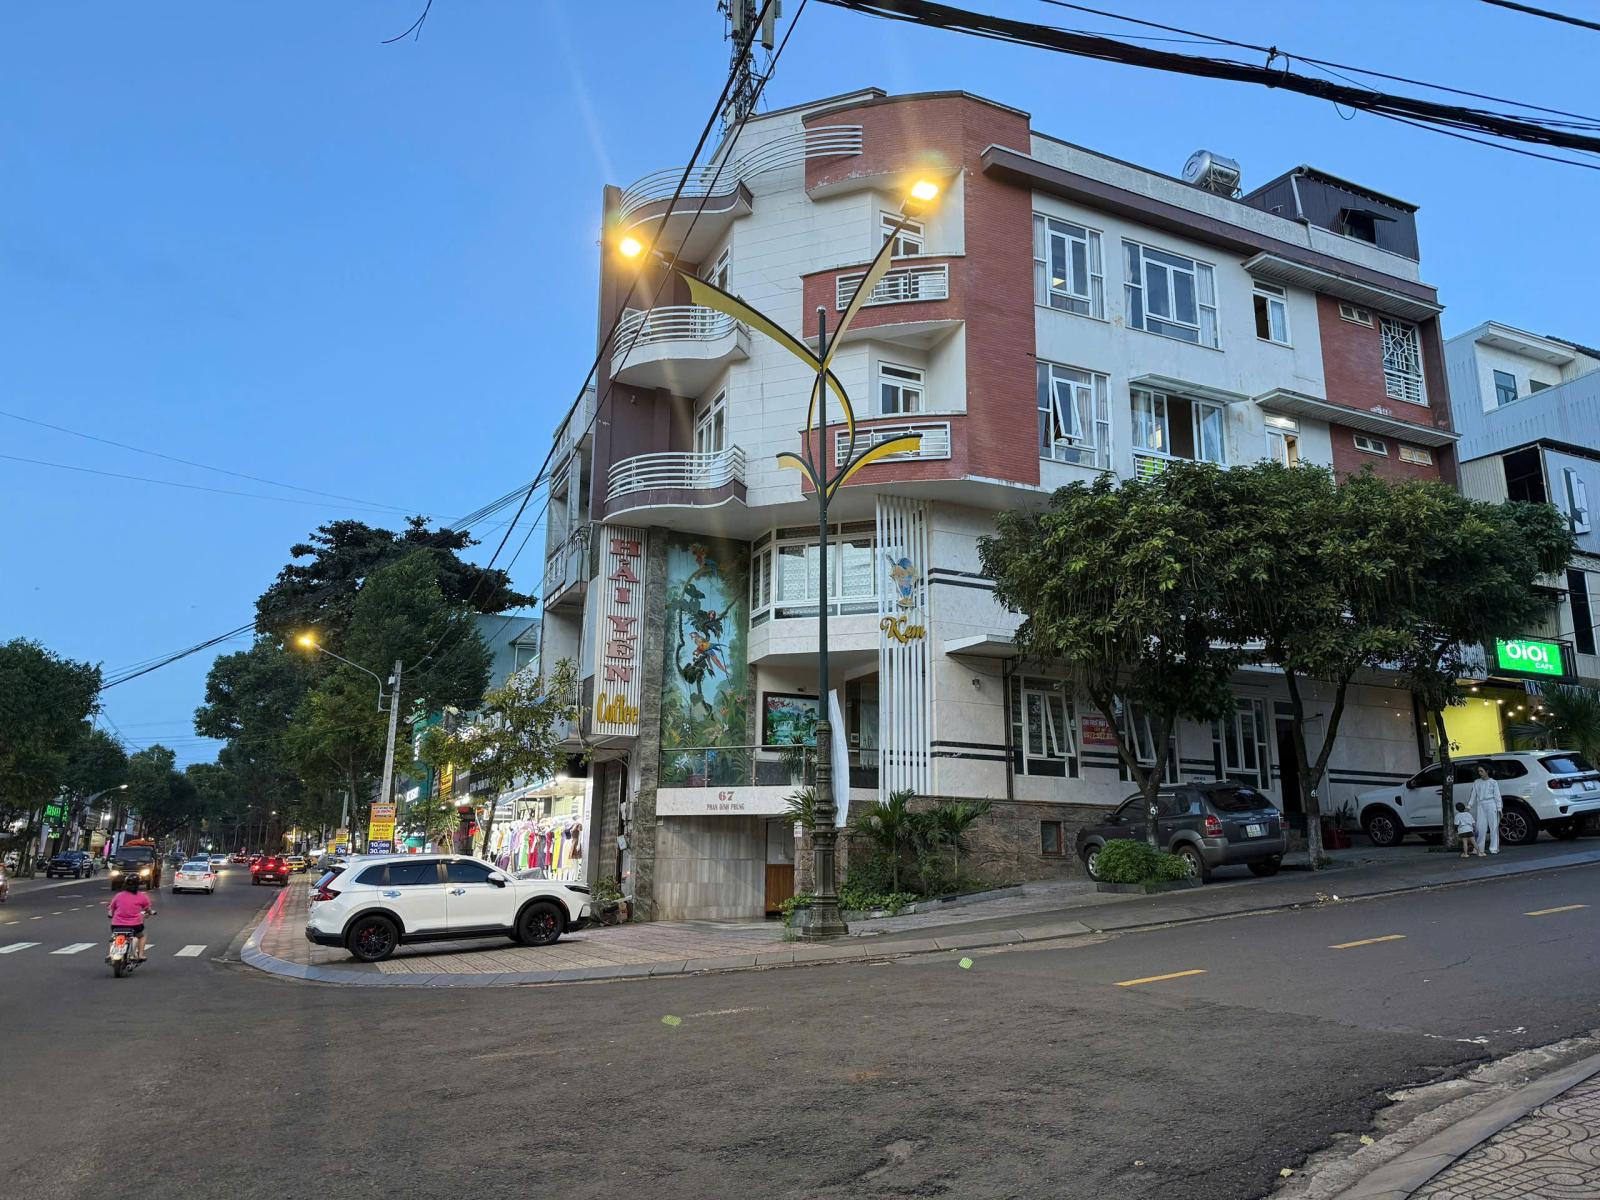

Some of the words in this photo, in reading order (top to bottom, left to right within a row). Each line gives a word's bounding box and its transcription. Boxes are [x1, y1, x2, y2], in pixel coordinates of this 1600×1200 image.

[880, 616, 926, 646] Kem
[605, 615, 637, 683] YẾN
[597, 692, 639, 725] Coffee
[718, 790, 735, 801] 67
